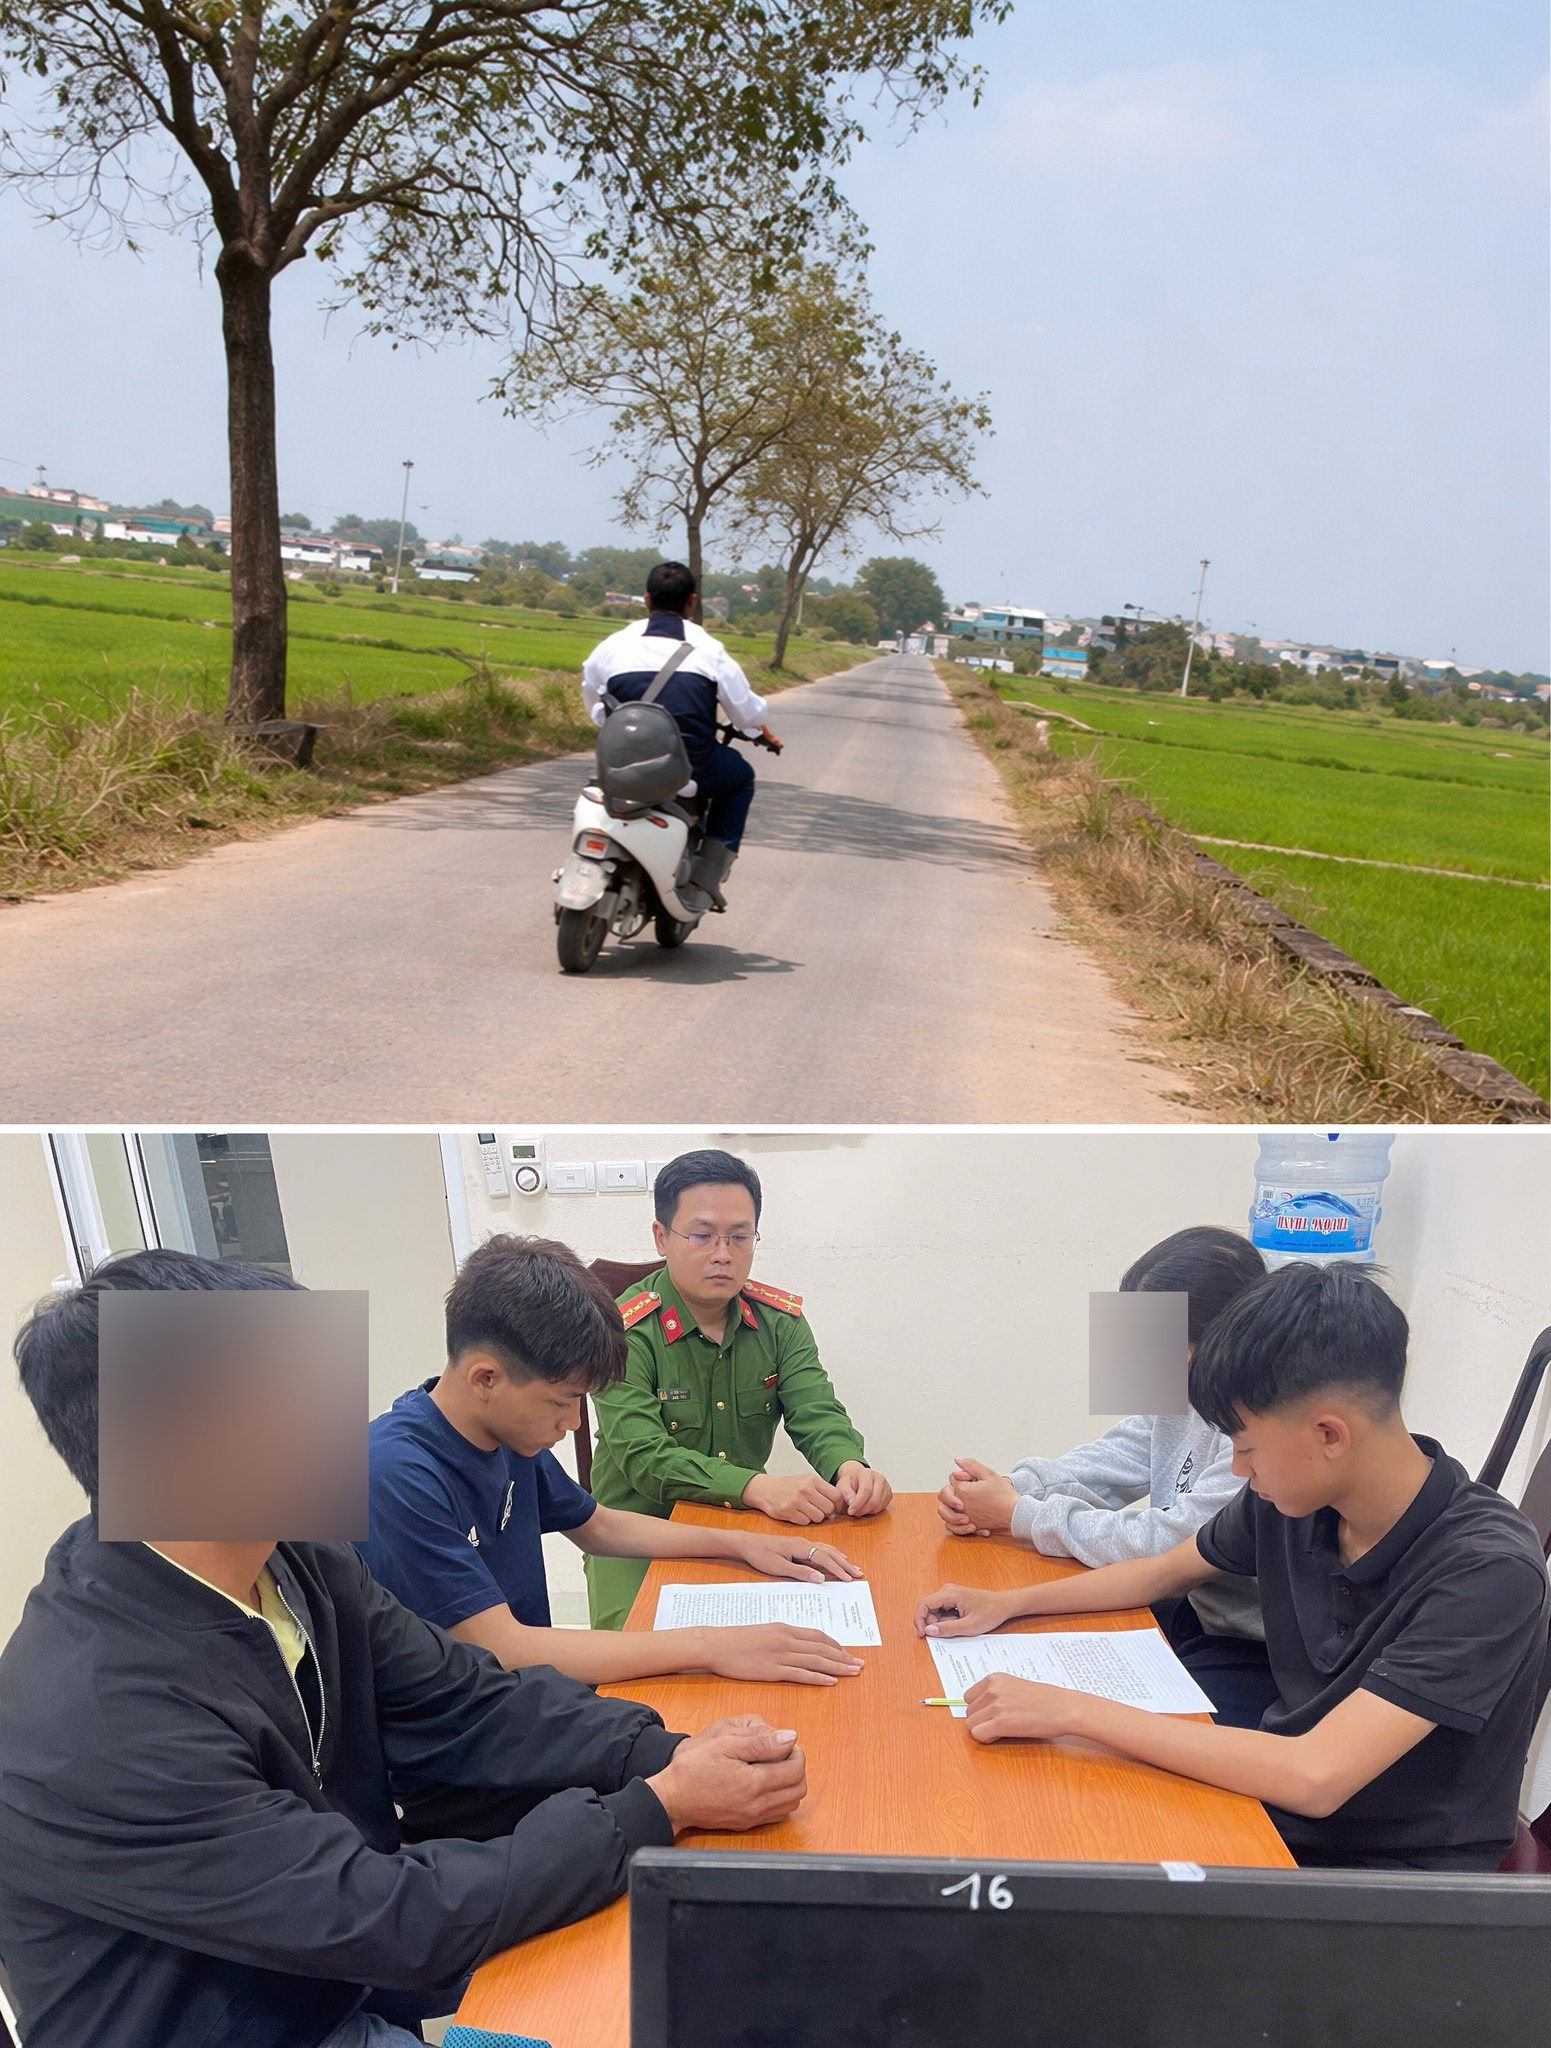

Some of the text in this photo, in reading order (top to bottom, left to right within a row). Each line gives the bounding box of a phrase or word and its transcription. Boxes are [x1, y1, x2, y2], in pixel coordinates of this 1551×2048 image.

[1277, 1216, 1308, 1234] THÀNH
[1311, 1216, 1348, 1235] TRƯỜNG
[941, 1872, 1014, 1910] 16
